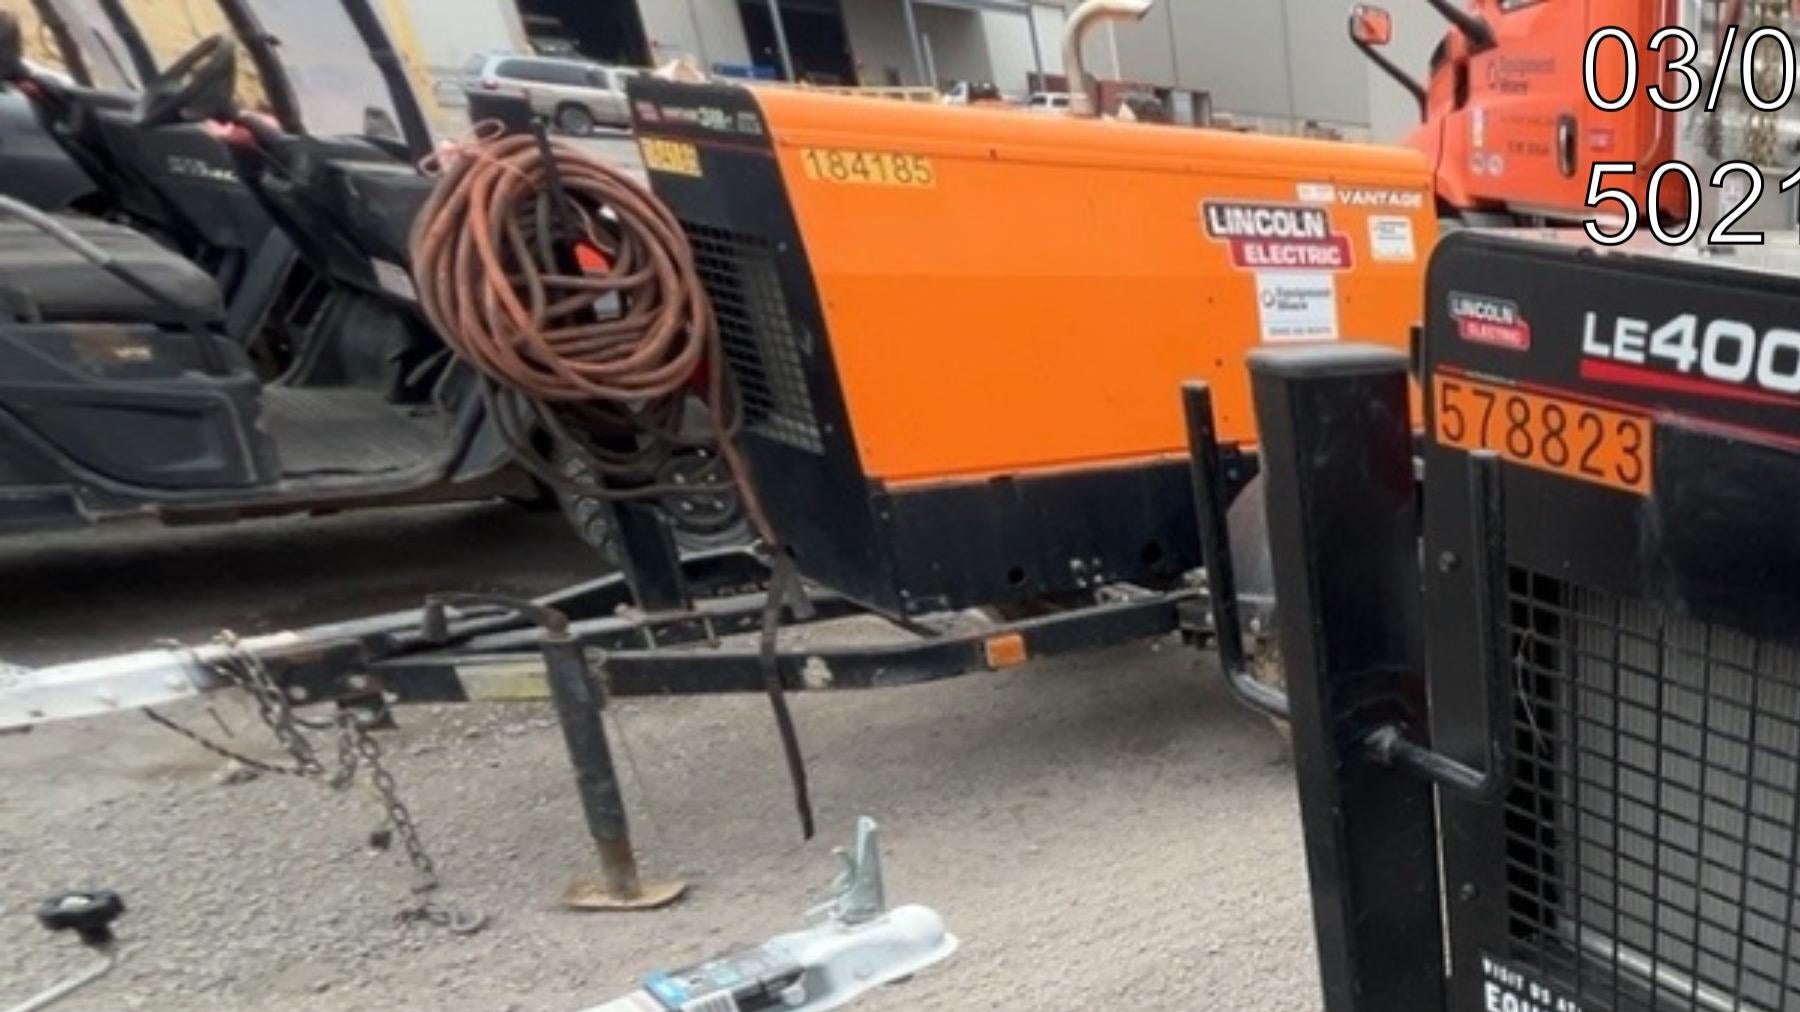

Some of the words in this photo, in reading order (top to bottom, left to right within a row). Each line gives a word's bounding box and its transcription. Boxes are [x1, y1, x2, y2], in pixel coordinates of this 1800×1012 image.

[807, 149, 931, 184] 184185
[1337, 189, 1423, 208] VANTAGE
[1207, 205, 1325, 238] LINCOLN
[1243, 242, 1343, 265] ELECTRIC
[1440, 382, 1644, 486] 578823
